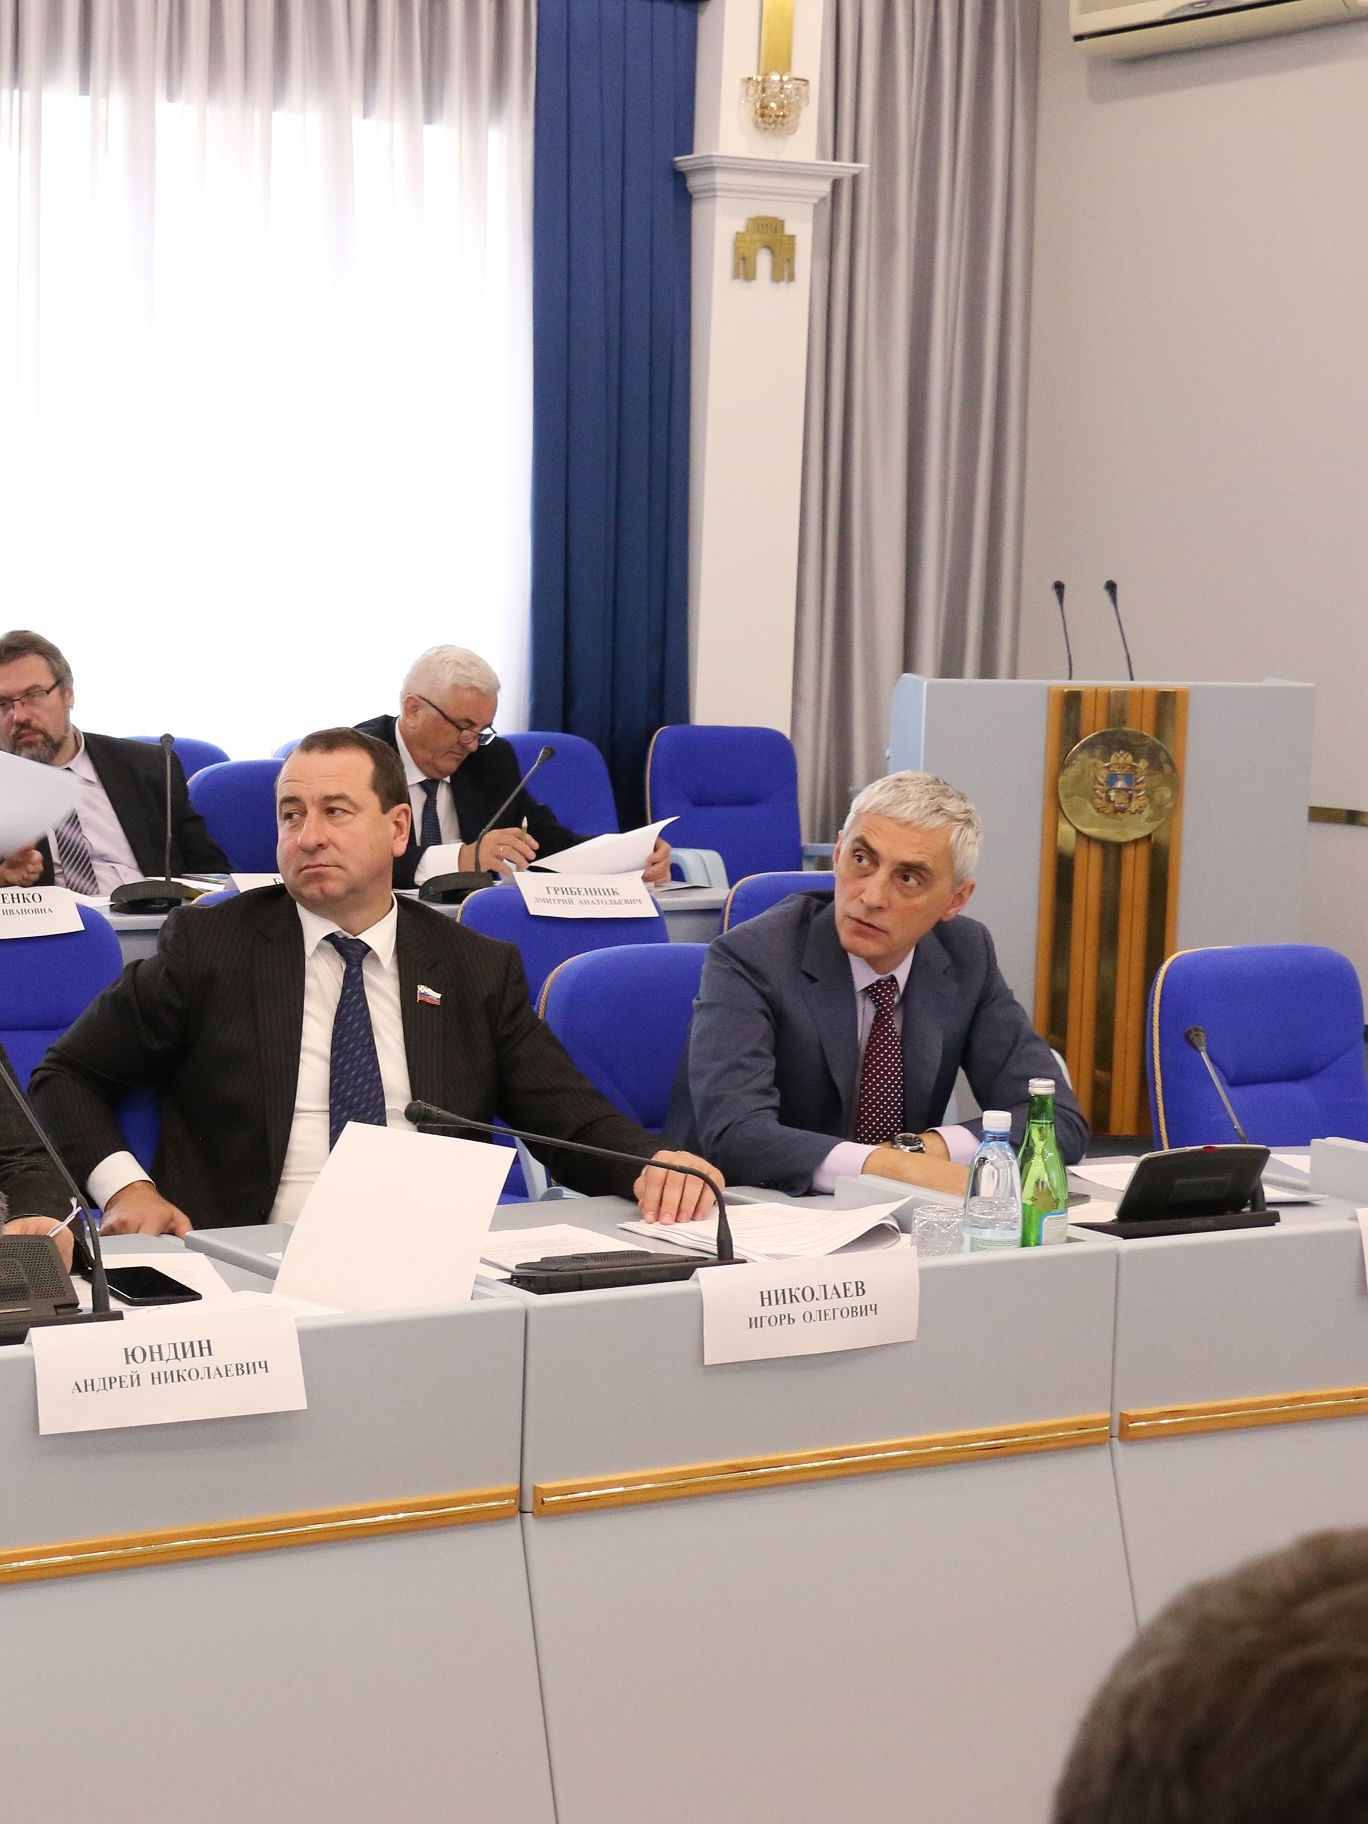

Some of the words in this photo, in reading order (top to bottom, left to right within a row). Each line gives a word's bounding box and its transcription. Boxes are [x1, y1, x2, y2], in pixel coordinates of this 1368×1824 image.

[546, 886, 620, 896] ГРИБЕННИК
[1, 906, 54, 917] ИВАНОВНА
[760, 1280, 866, 1307] НИКОЛАЕВ
[748, 1314, 795, 1329] ИГОРЬ
[802, 1303, 878, 1323] ОЛЕГОВИЧ
[123, 1339, 214, 1365] ЮНДИН
[71, 1370, 141, 1394] АНДРЕЙ
[150, 1360, 269, 1386] НИКОЛАЕВИЧ
